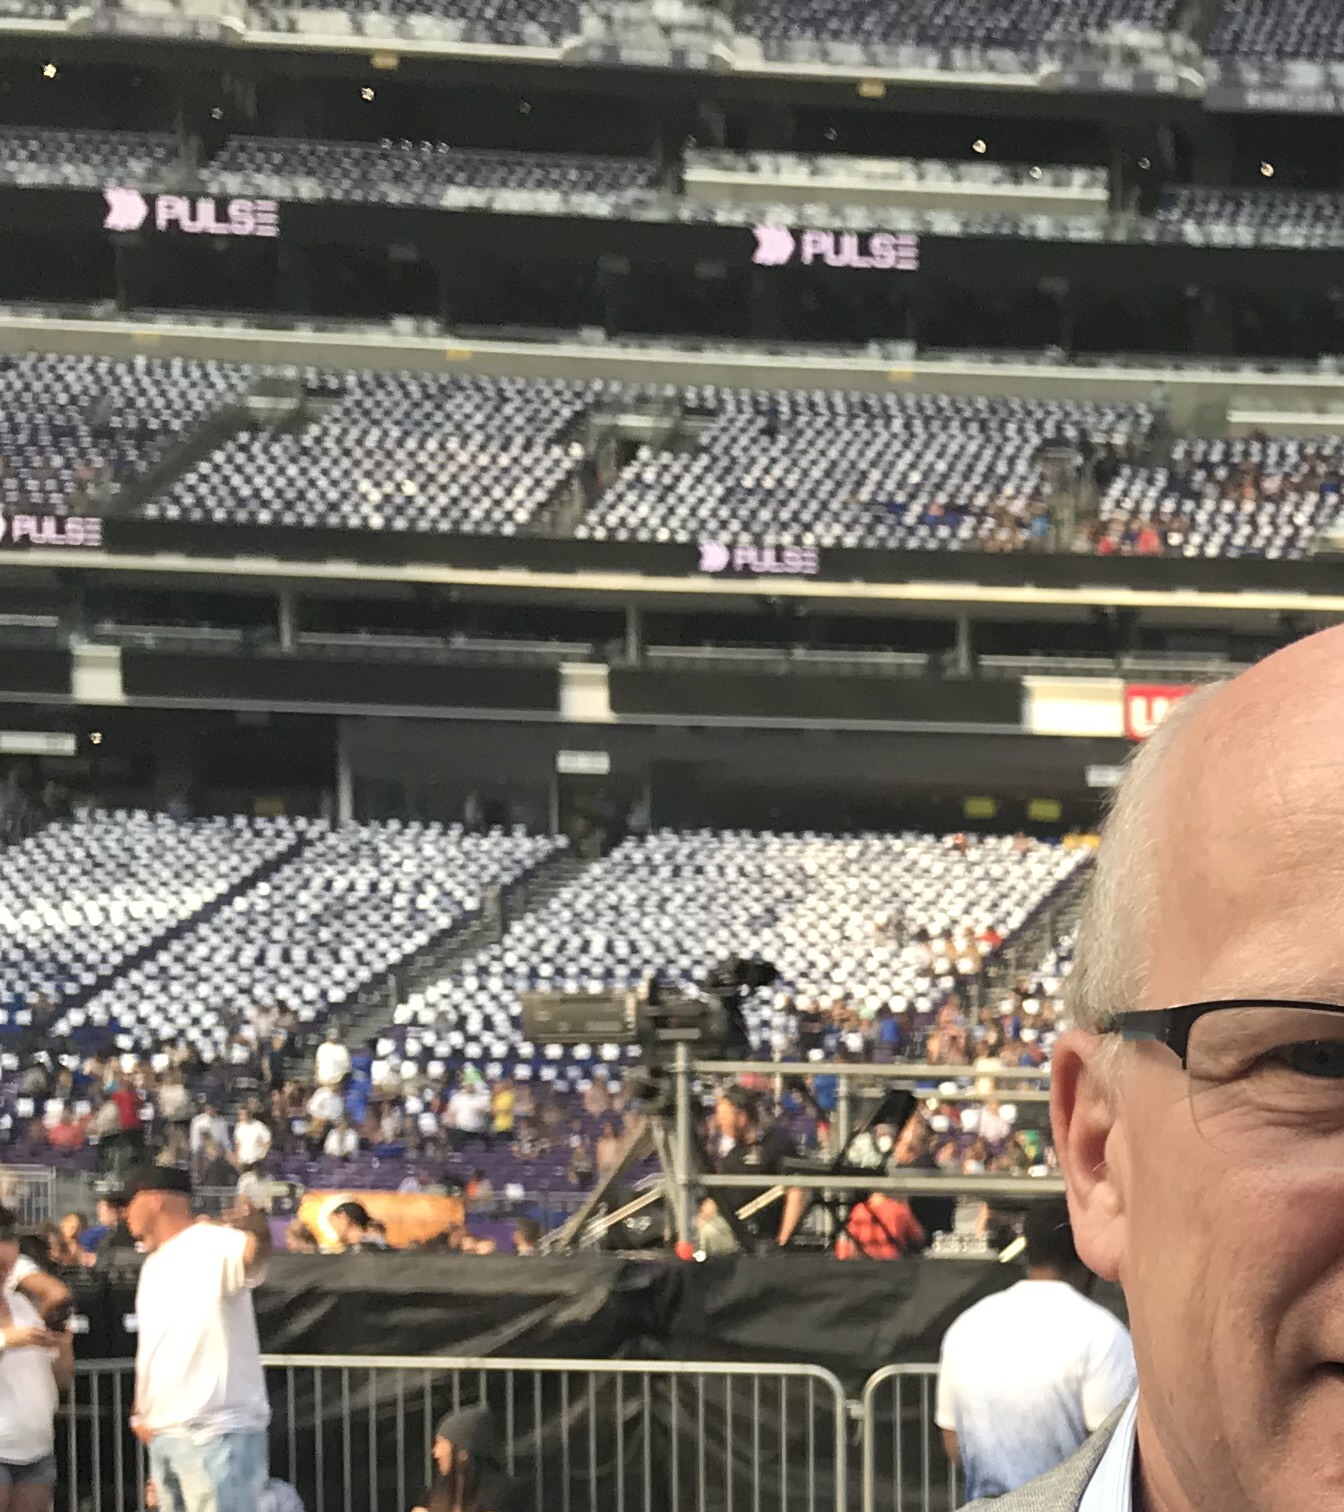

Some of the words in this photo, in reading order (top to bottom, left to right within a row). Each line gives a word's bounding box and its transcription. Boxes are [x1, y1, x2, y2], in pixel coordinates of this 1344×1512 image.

[156, 195, 279, 236] PULSE
[802, 230, 919, 271] PULSE
[12, 514, 102, 547] PULSE
[733, 545, 819, 574] PULSE
